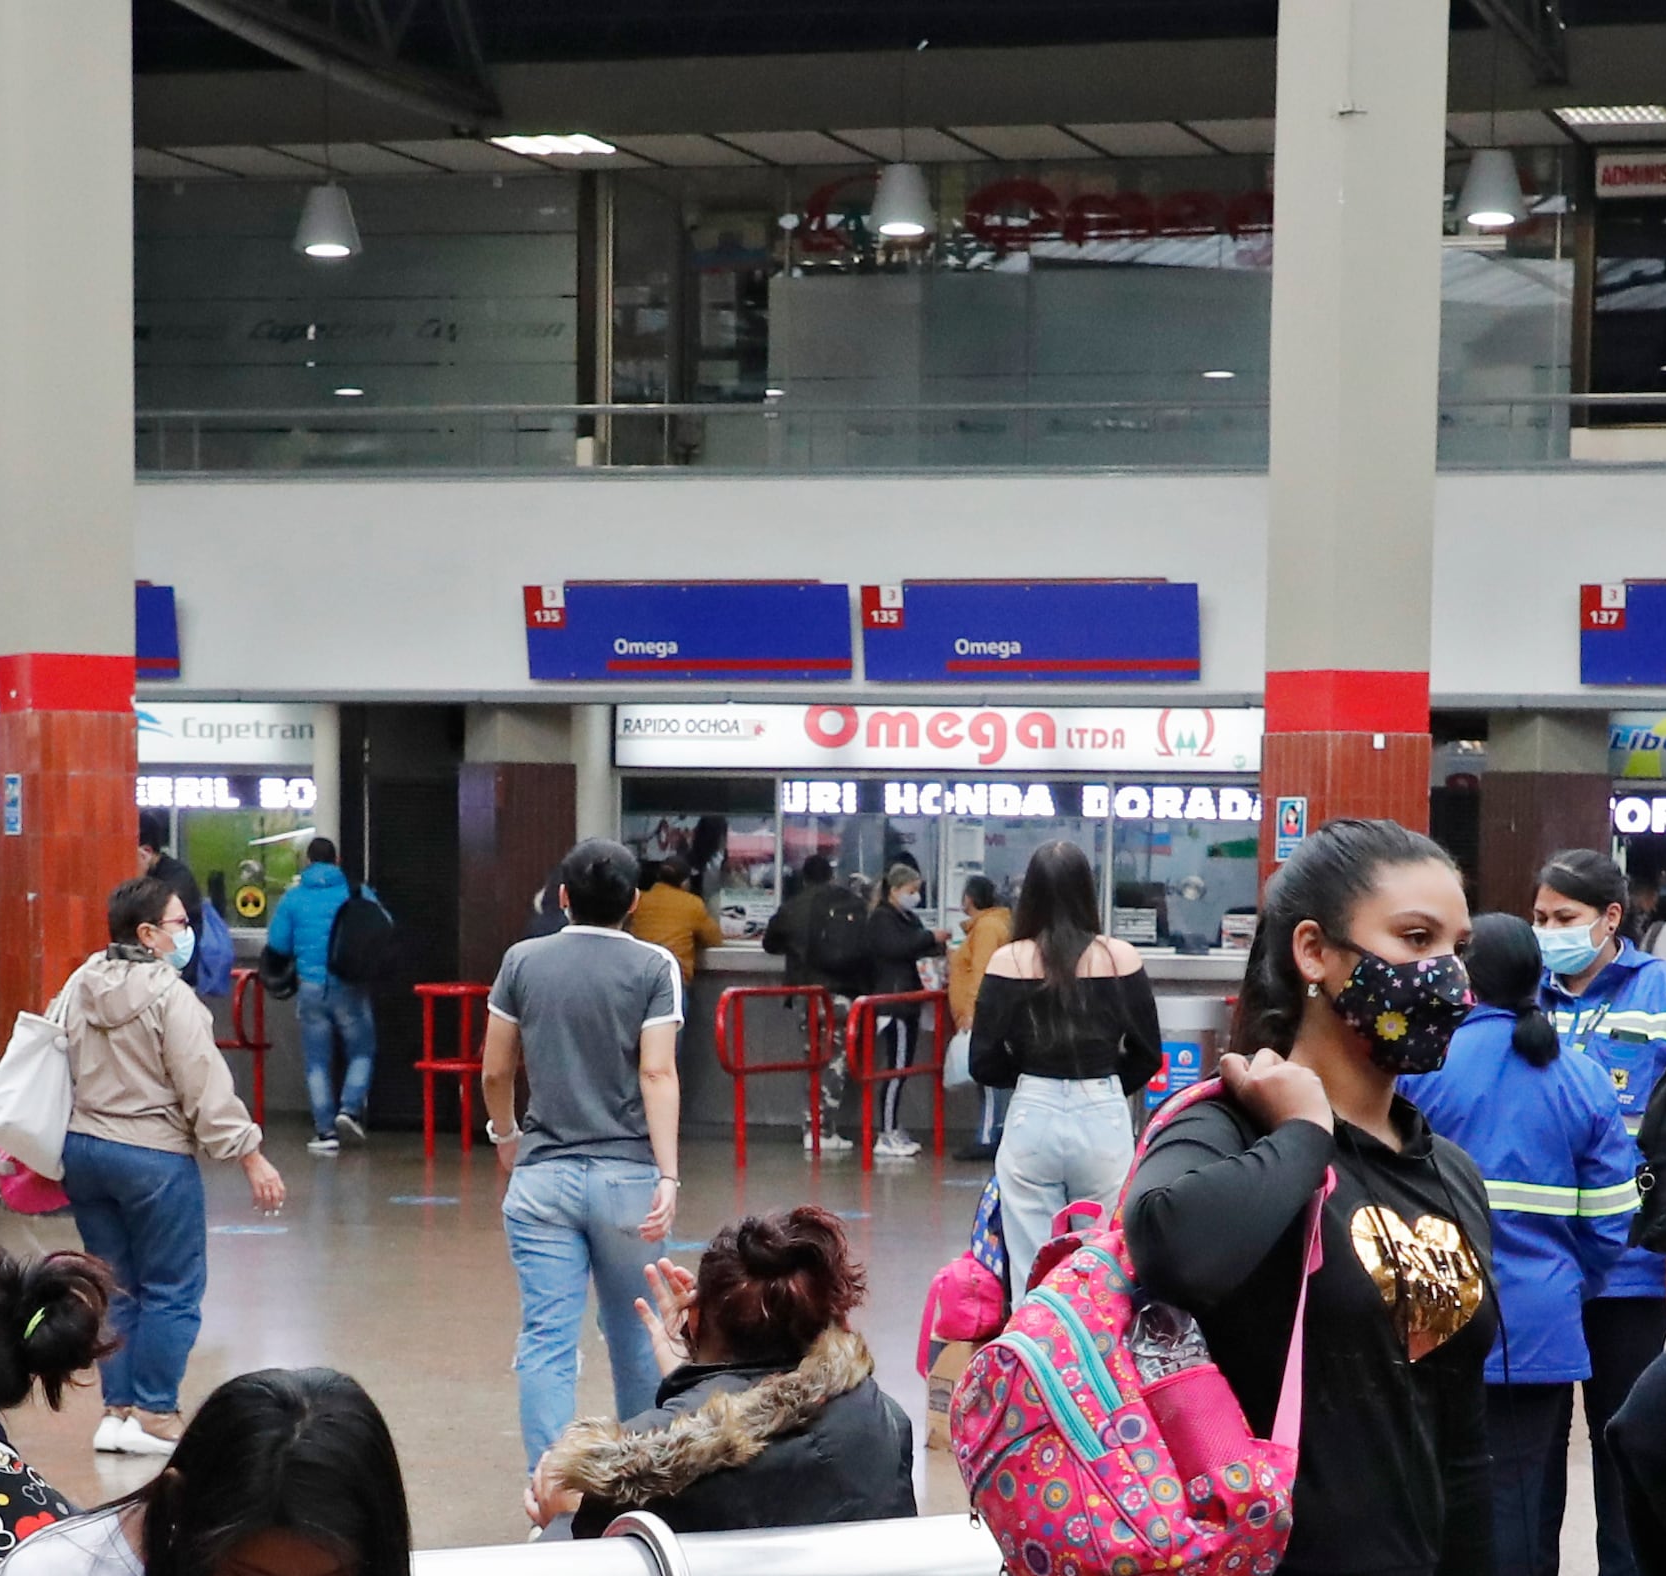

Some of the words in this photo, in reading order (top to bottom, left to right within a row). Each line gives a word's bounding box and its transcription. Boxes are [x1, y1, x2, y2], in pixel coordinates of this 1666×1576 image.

[1609, 589, 1618, 601] 3
[534, 609, 561, 623] 135
[871, 610, 898, 624] 135
[1590, 611, 1619, 625] 137
[613, 638, 679, 658] Omega
[954, 638, 1022, 658] Omega
[181, 715, 315, 743] Copetran
[623, 718, 680, 735] RAPIDO
[685, 717, 741, 735] OCHOA
[803, 703, 1056, 766] Omega
[1066, 727, 1125, 750] LTDA
[884, 782, 1056, 816] HONDA
